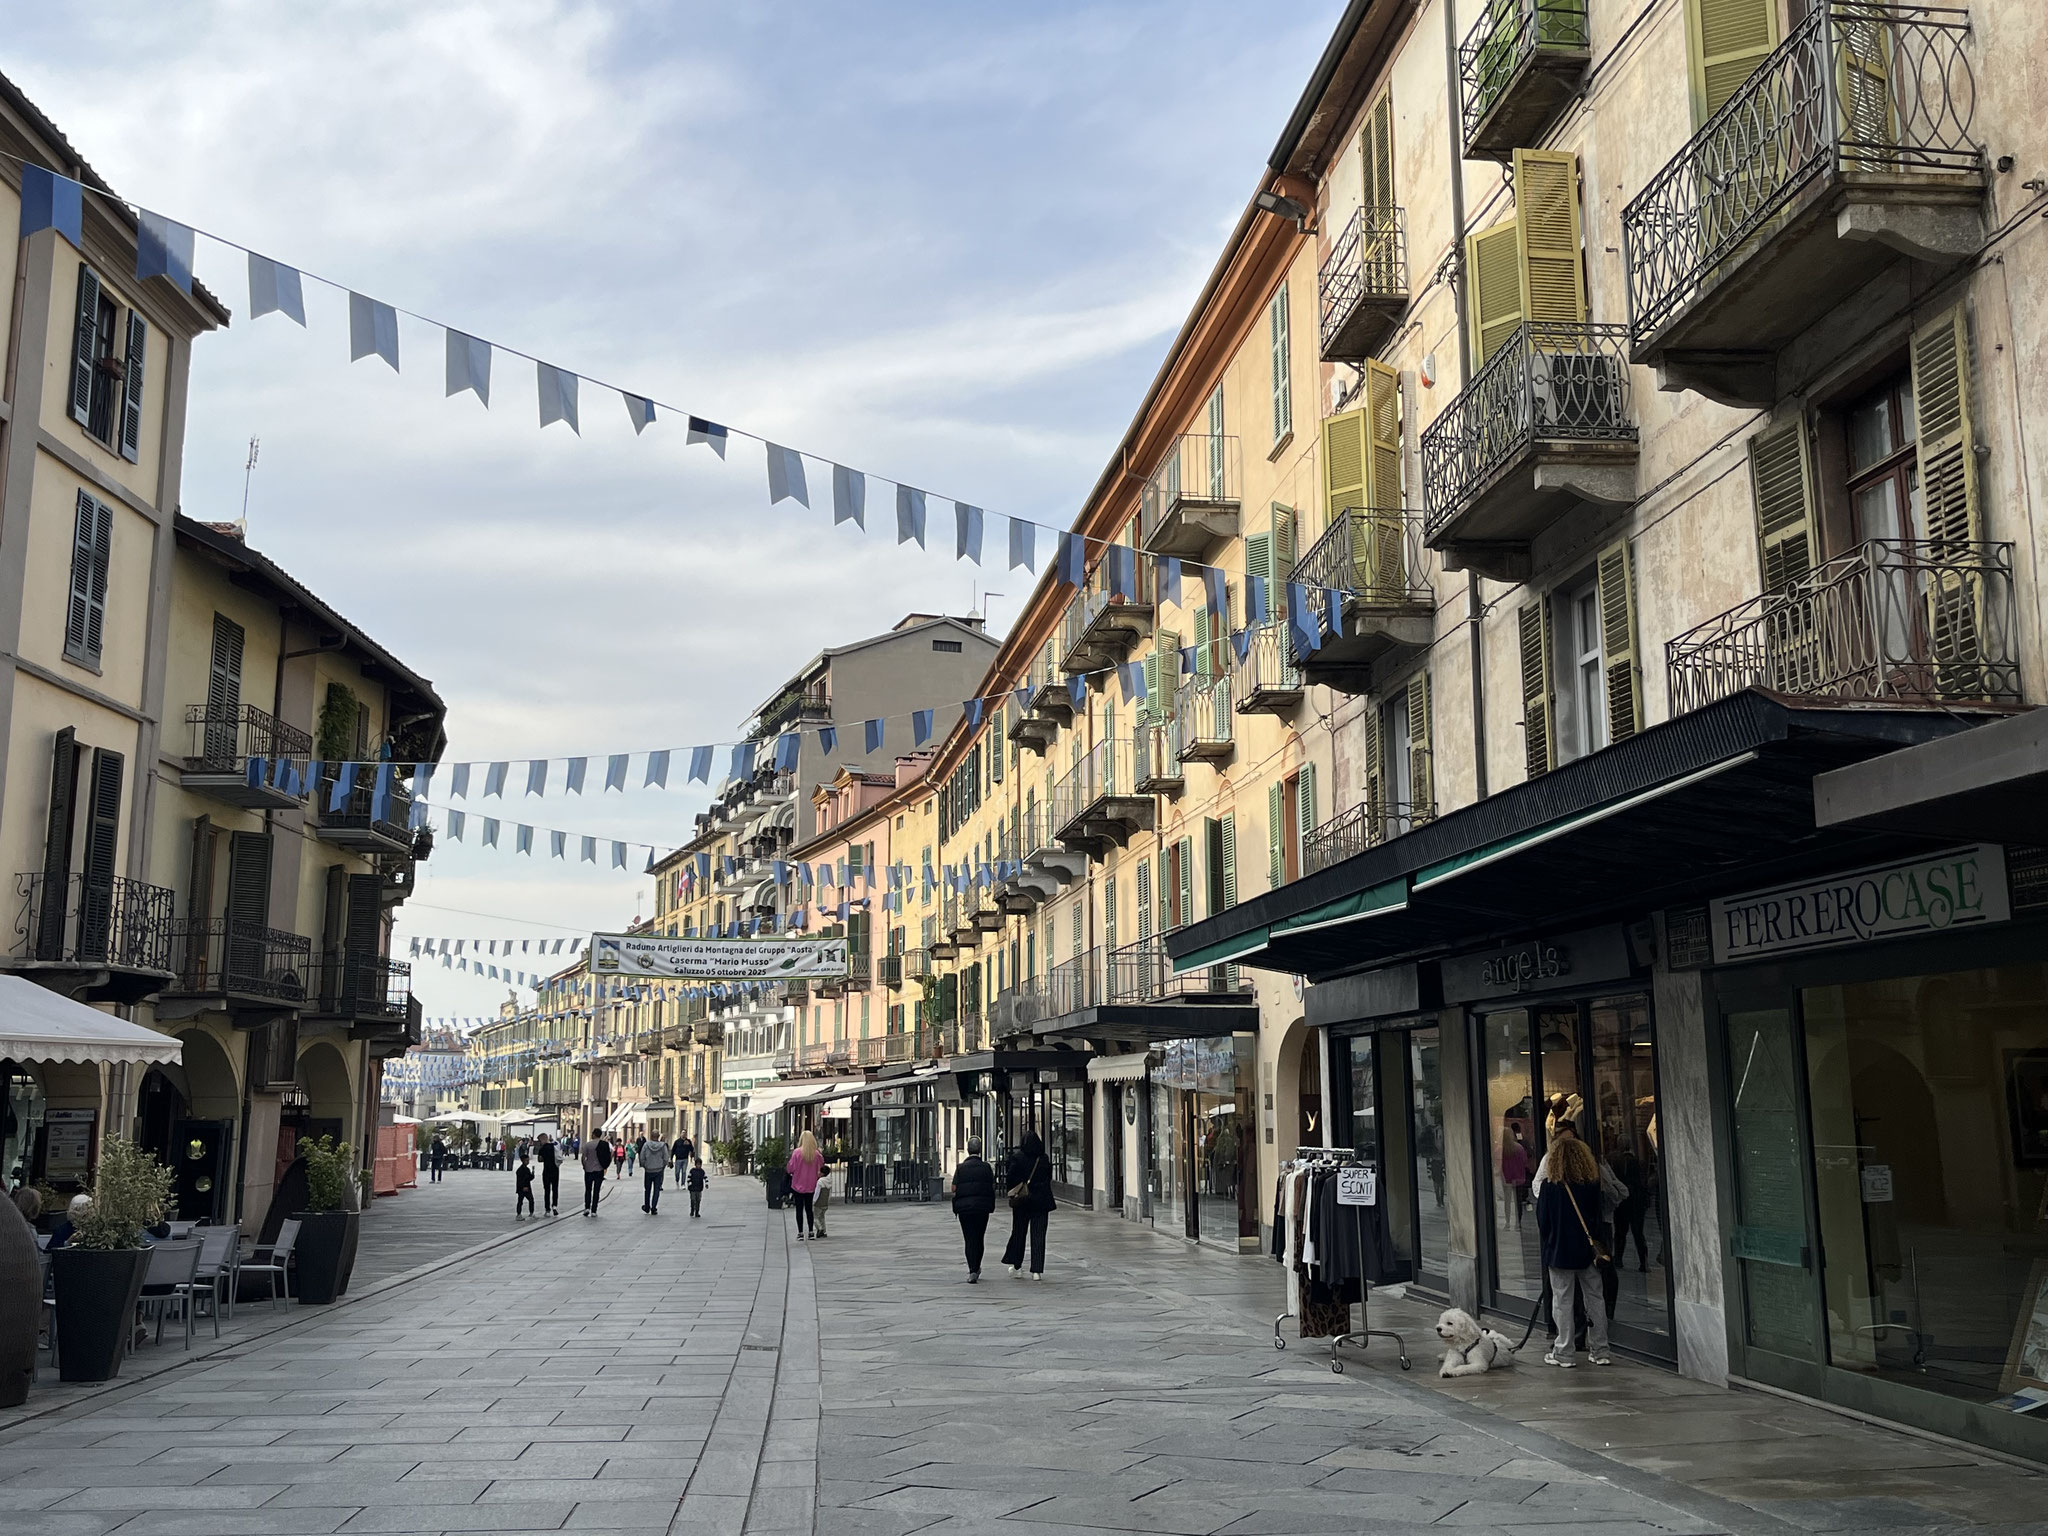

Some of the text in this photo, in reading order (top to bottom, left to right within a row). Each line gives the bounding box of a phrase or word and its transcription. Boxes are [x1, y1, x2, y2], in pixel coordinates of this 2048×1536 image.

[626, 943, 656, 951] Raduno
[658, 944, 693, 954] Artiglieri
[694, 945, 704, 953] da
[705, 946, 744, 955] Montagna
[758, 947, 786, 956] Gruppo
[669, 957, 708, 965] Caserma
[1482, 940, 1559, 994] angels
[674, 967, 705, 975] Saluzzo
[717, 968, 747, 976] ottobre
[748, 968, 767, 976] 2025
[1342, 1169, 1369, 1180] SUPER
[1341, 1180, 1374, 1195] SCONTI
